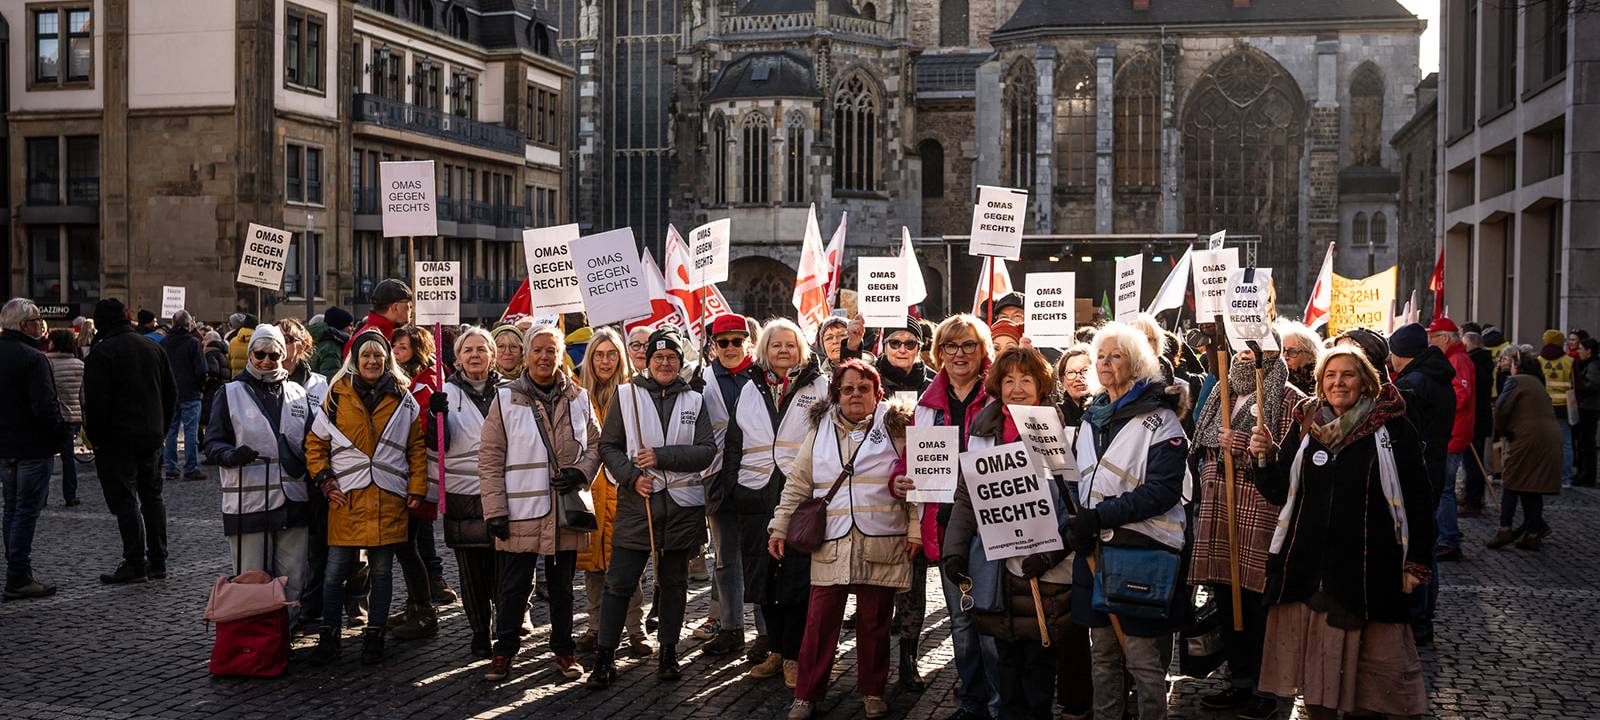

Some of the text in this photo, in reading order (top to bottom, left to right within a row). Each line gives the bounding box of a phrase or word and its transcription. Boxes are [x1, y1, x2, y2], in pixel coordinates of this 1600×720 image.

[392, 181, 421, 189] OMAS
[389, 192, 425, 200] GEGEN
[389, 203, 430, 212] RECHTS
[987, 201, 1013, 210] OMAS
[984, 213, 1014, 221] GEGEN
[697, 228, 711, 240] OMAS
[980, 224, 1016, 233] RECHTS
[256, 230, 284, 243] OMAS
[250, 243, 283, 257] GEGEN
[535, 245, 568, 258] OMAS
[696, 241, 712, 255] GEGEN
[245, 255, 283, 271] RECHTS
[588, 252, 623, 268] OMAS
[695, 255, 713, 270] RECHTS
[423, 262, 450, 272] OMAS
[533, 261, 573, 274] GEGEN
[587, 265, 630, 282] GEGEN
[1121, 269, 1134, 278] OMAS
[420, 277, 453, 286] GEGEN
[533, 276, 578, 290] RECHTS
[589, 277, 638, 296] RECHTS
[1120, 280, 1135, 290] GEGEN
[417, 291, 456, 300] RECHTS
[1119, 291, 1136, 301] RECHTS
[1034, 300, 1064, 308] GEGEN
[1029, 434, 1057, 443] GEGEN
[1032, 446, 1065, 456] RECHTS
[976, 450, 1028, 475] OMAS
[977, 474, 1038, 500] GEGEN
[979, 499, 1050, 525] RECHTS
